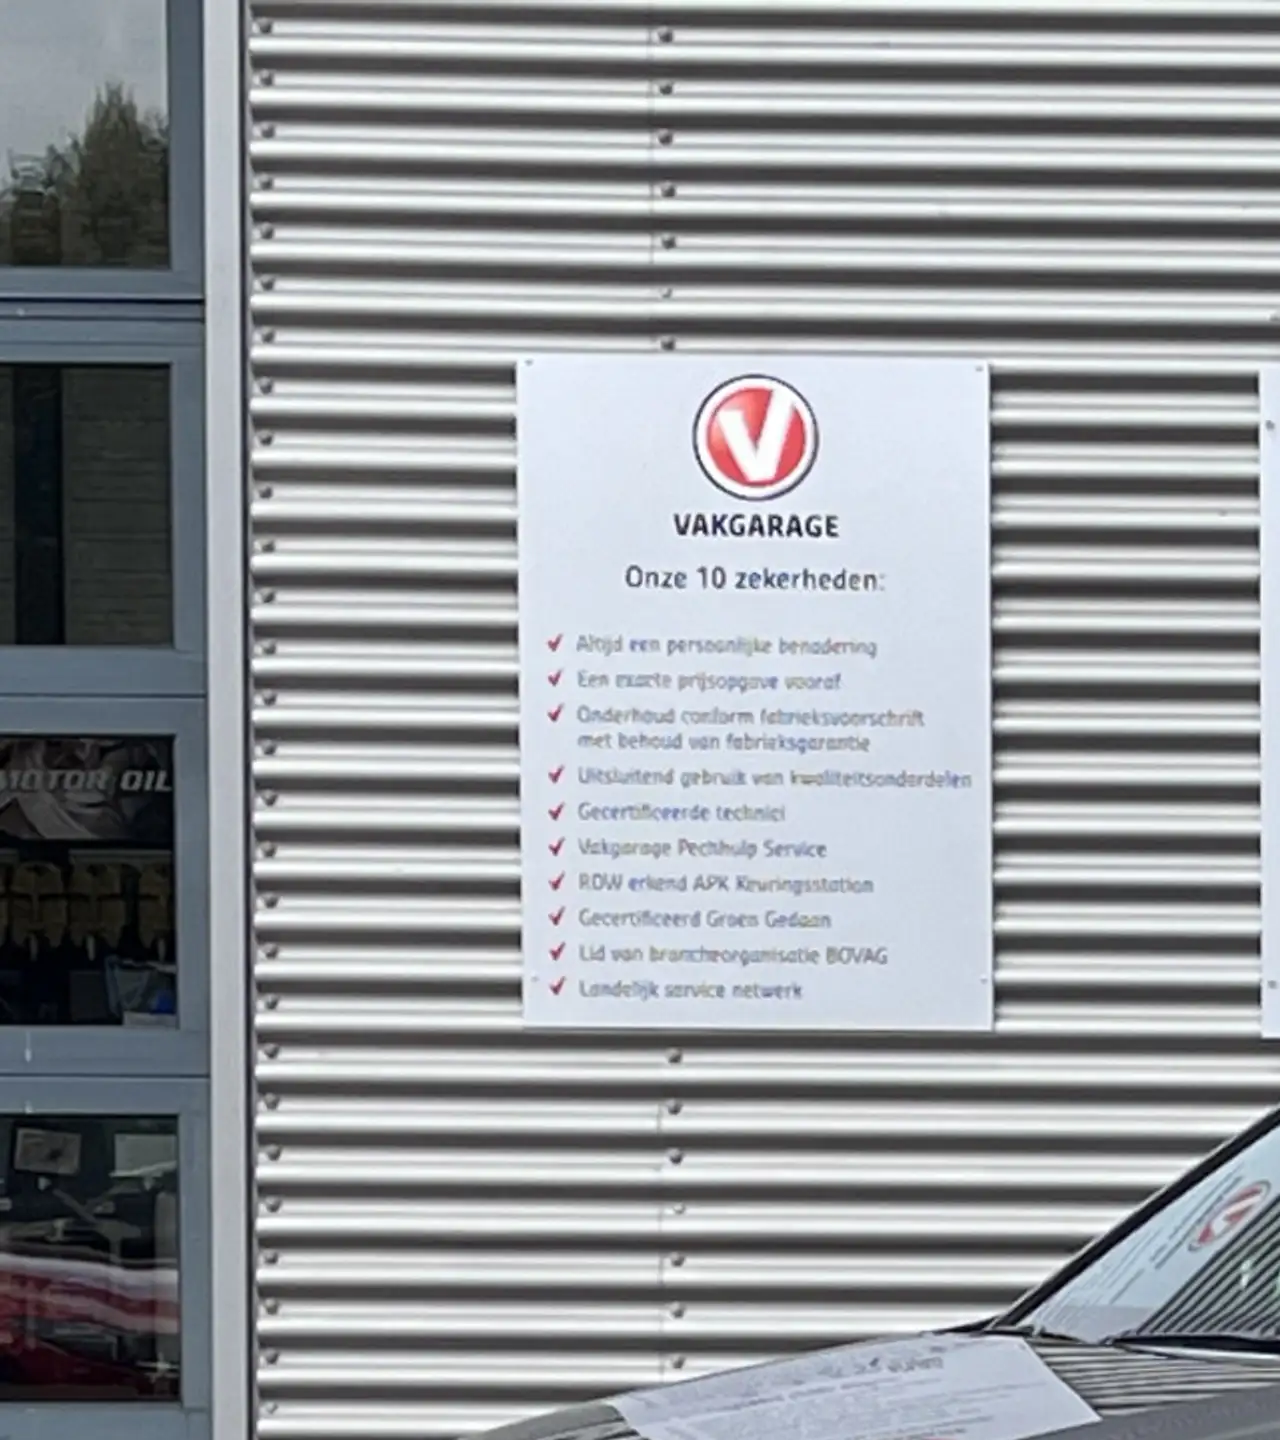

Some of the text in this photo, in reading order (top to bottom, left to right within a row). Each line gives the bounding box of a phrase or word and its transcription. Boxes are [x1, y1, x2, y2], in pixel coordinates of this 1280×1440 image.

[674, 512, 840, 539] VAKGARAGE
[625, 565, 886, 592] Onze 10 zekerheden:
[576, 634, 878, 659] Altijd een persoonlijke benadering
[577, 670, 610, 688] Een
[677, 672, 779, 694] prijsopgave
[784, 672, 841, 690] vooraf
[577, 705, 925, 727] Onderhoud conform fabrieksvoorschrift
[577, 732, 870, 754] met behoud van fabrieksgarantie
[120, 769, 173, 792] OIL
[578, 766, 973, 789] Uitsluitend gebruik van kwaliteitsonderdelen
[578, 802, 786, 822] Gecertificeerde technici
[578, 837, 827, 860] Vakgarage Pechhulp Service
[578, 873, 875, 896] RDW erkend APK Keuringsstation
[578, 908, 832, 929] Gecertificeerd Groen Gedaan
[579, 945, 889, 967] Lid van brancheorganisatie BOVAG
[579, 980, 803, 1002] Landelijk service netwerk
